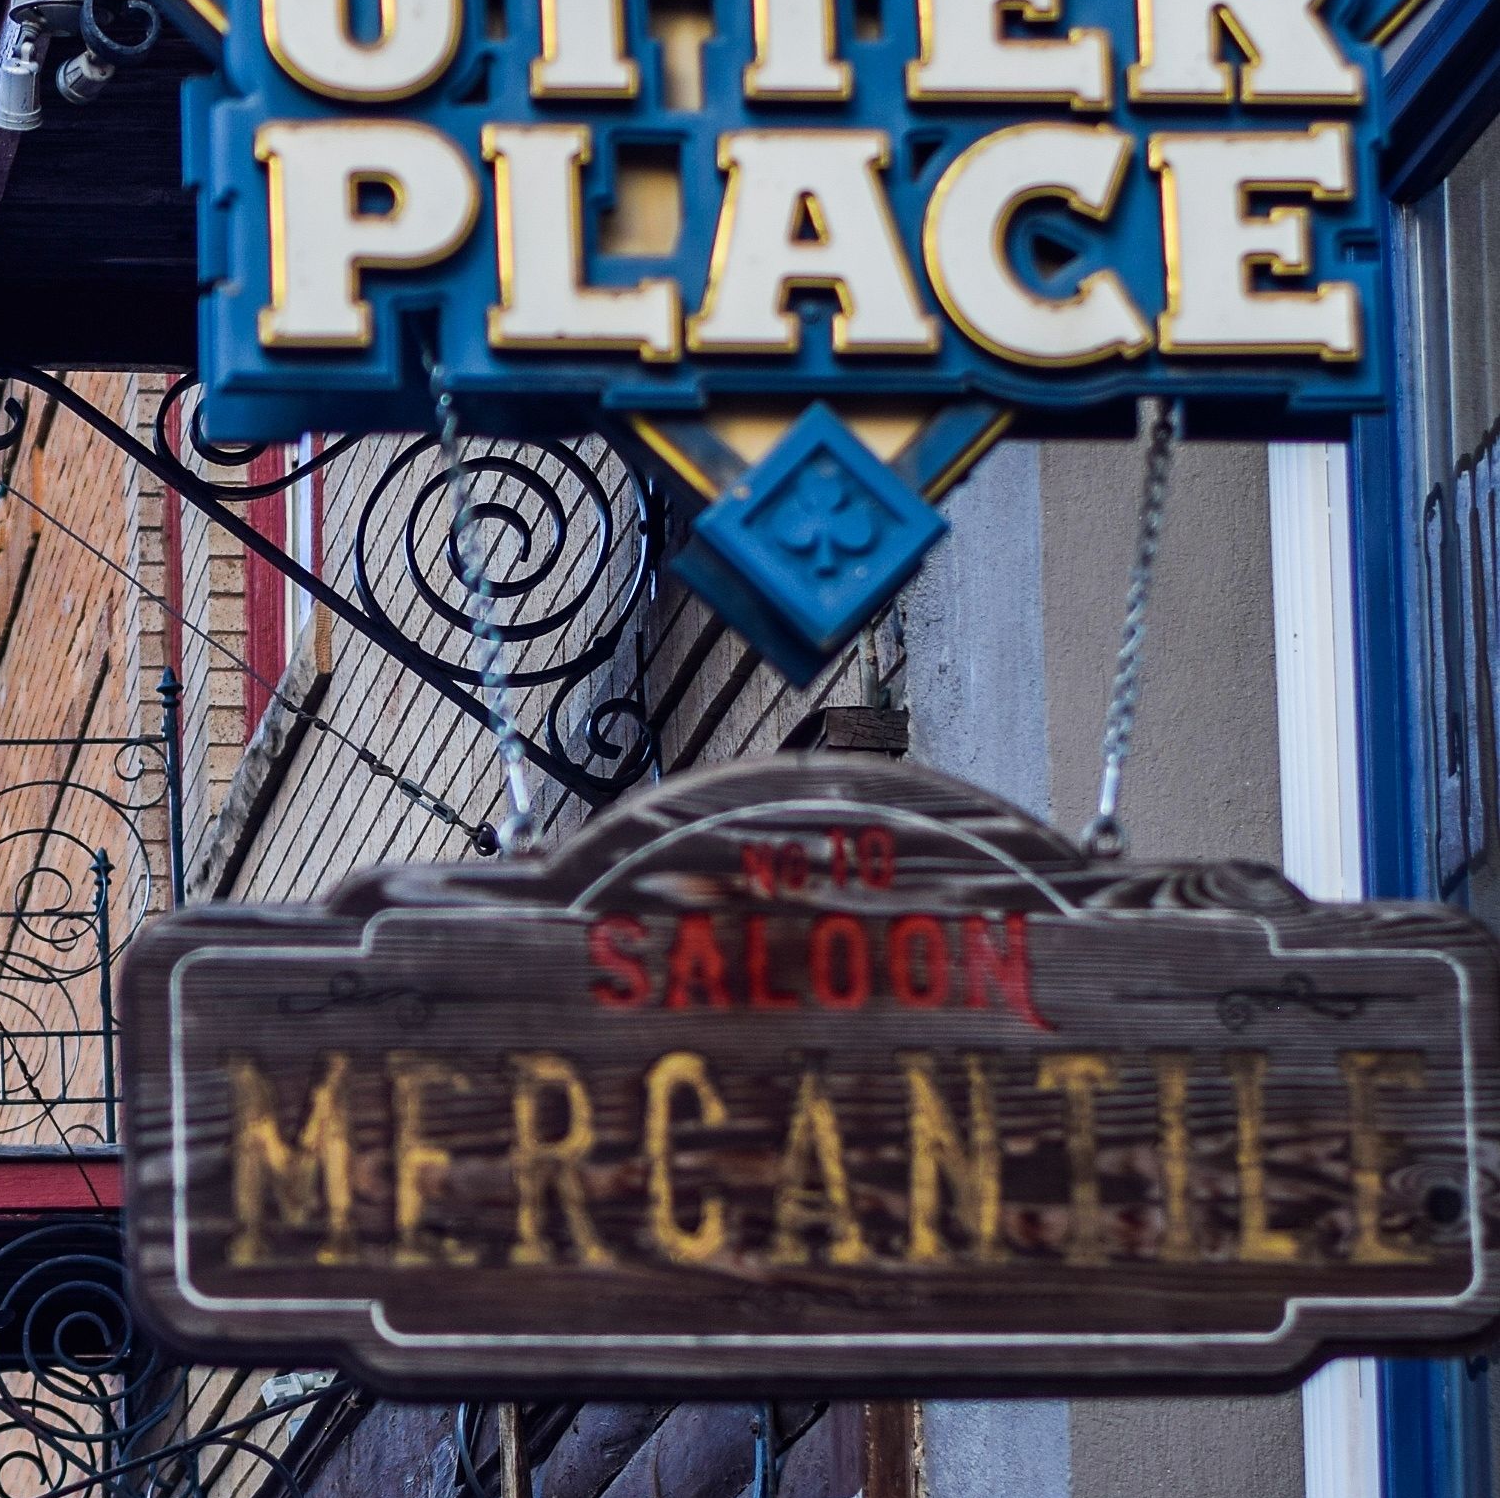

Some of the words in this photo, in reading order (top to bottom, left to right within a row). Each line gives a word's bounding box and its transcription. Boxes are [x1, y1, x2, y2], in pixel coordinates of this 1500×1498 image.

[253, 122, 1356, 367] PLACE
[586, 909, 1058, 1033] SALOON
[226, 1048, 1434, 1267] MERCANTILE
